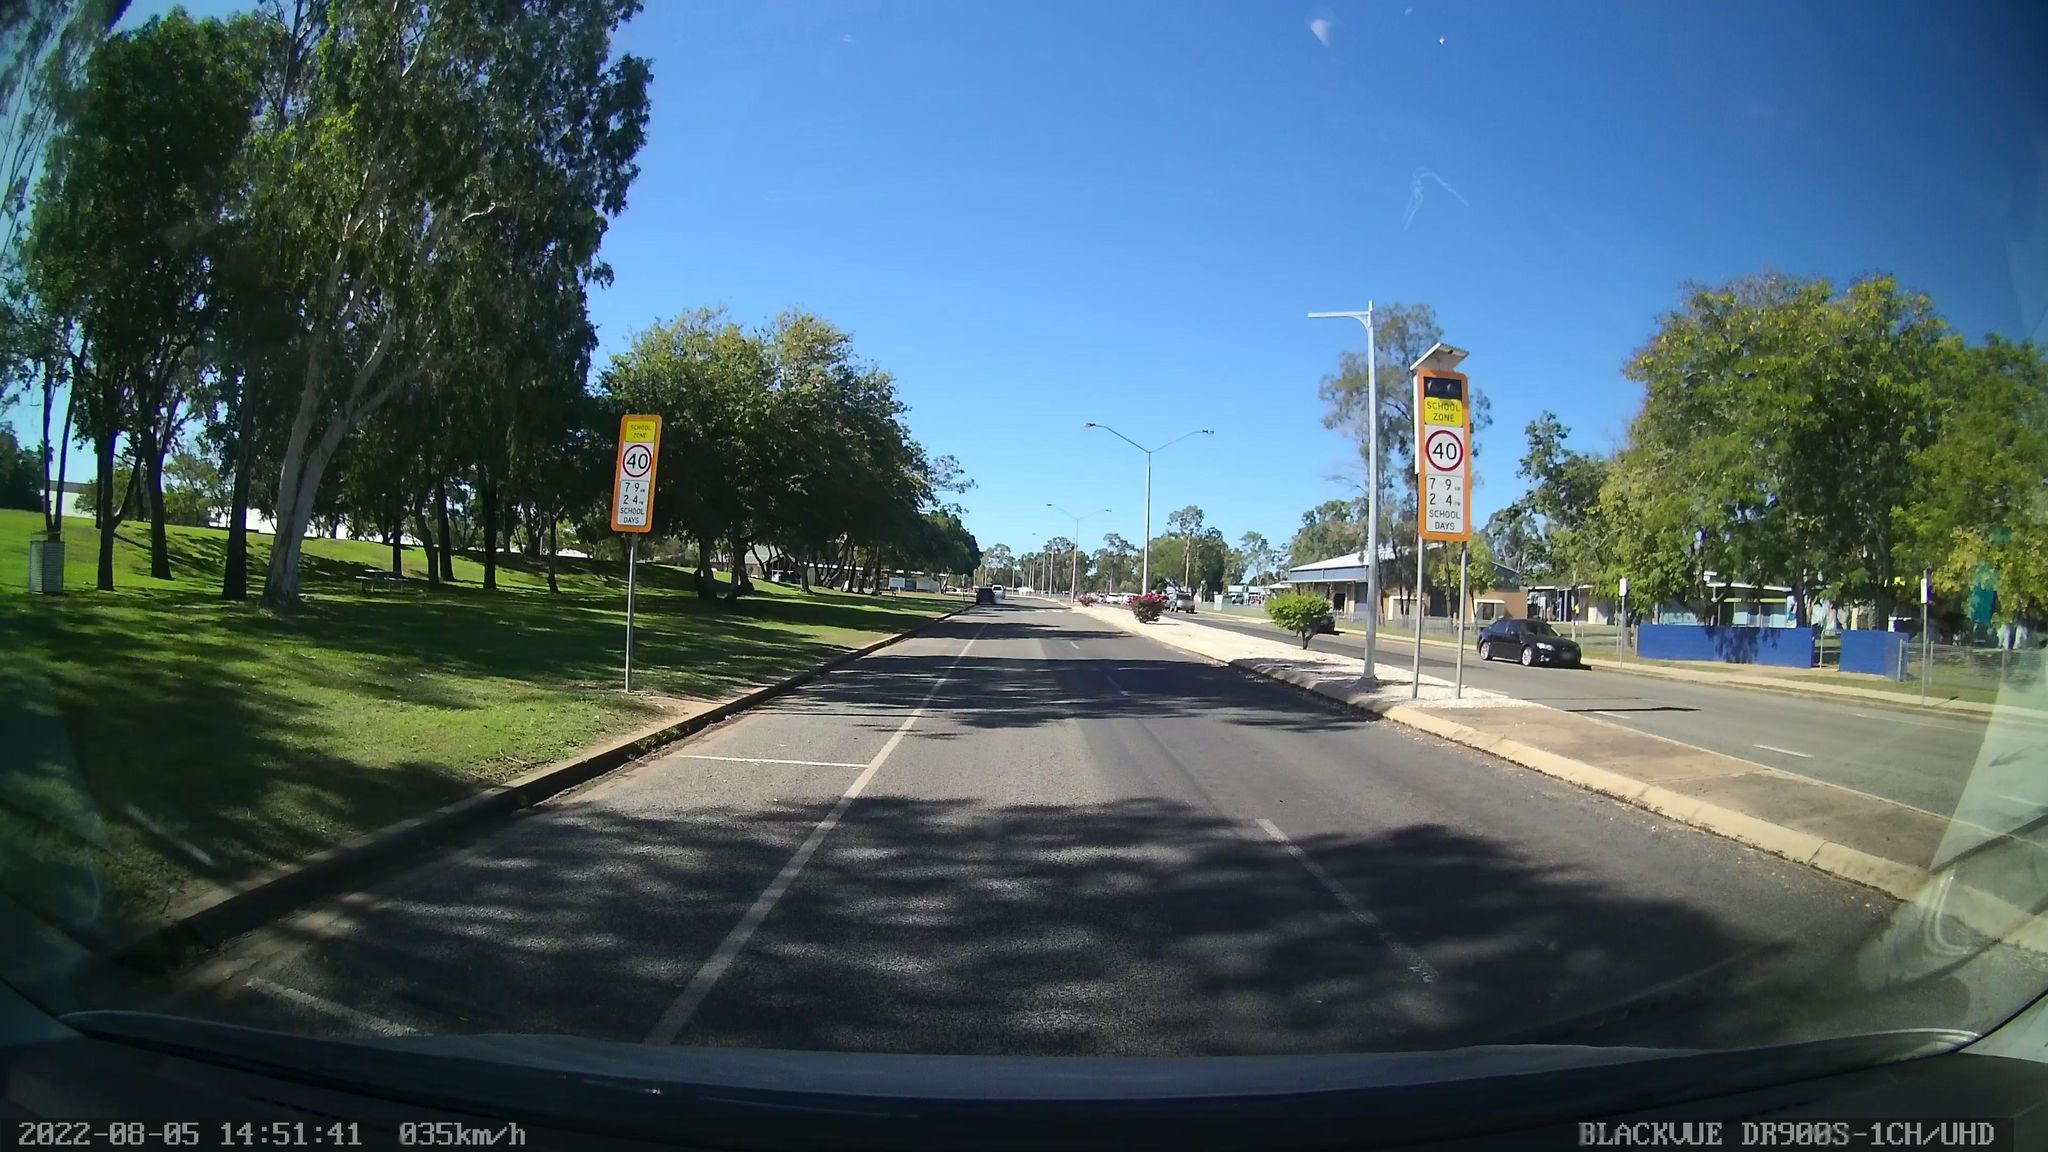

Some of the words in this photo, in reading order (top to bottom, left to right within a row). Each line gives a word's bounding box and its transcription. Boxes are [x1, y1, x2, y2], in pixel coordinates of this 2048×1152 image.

[1427, 402, 1460, 412] SCHOOL
[1433, 413, 1455, 422] ZONE
[1433, 442, 1457, 460] 40
[626, 453, 648, 469] 40
[625, 482, 631, 492] 7
[634, 482, 640, 492] 9
[1429, 477, 1436, 490] 7
[1445, 478, 1452, 491] 9
[623, 494, 629, 505] 2
[632, 495, 638, 505] 4
[1429, 493, 1436, 505] 2
[1445, 494, 1452, 506] 4
[620, 507, 645, 515] SCHOOL
[1429, 510, 1461, 519] SCHOOL
[1434, 521, 1455, 531] DAYS
